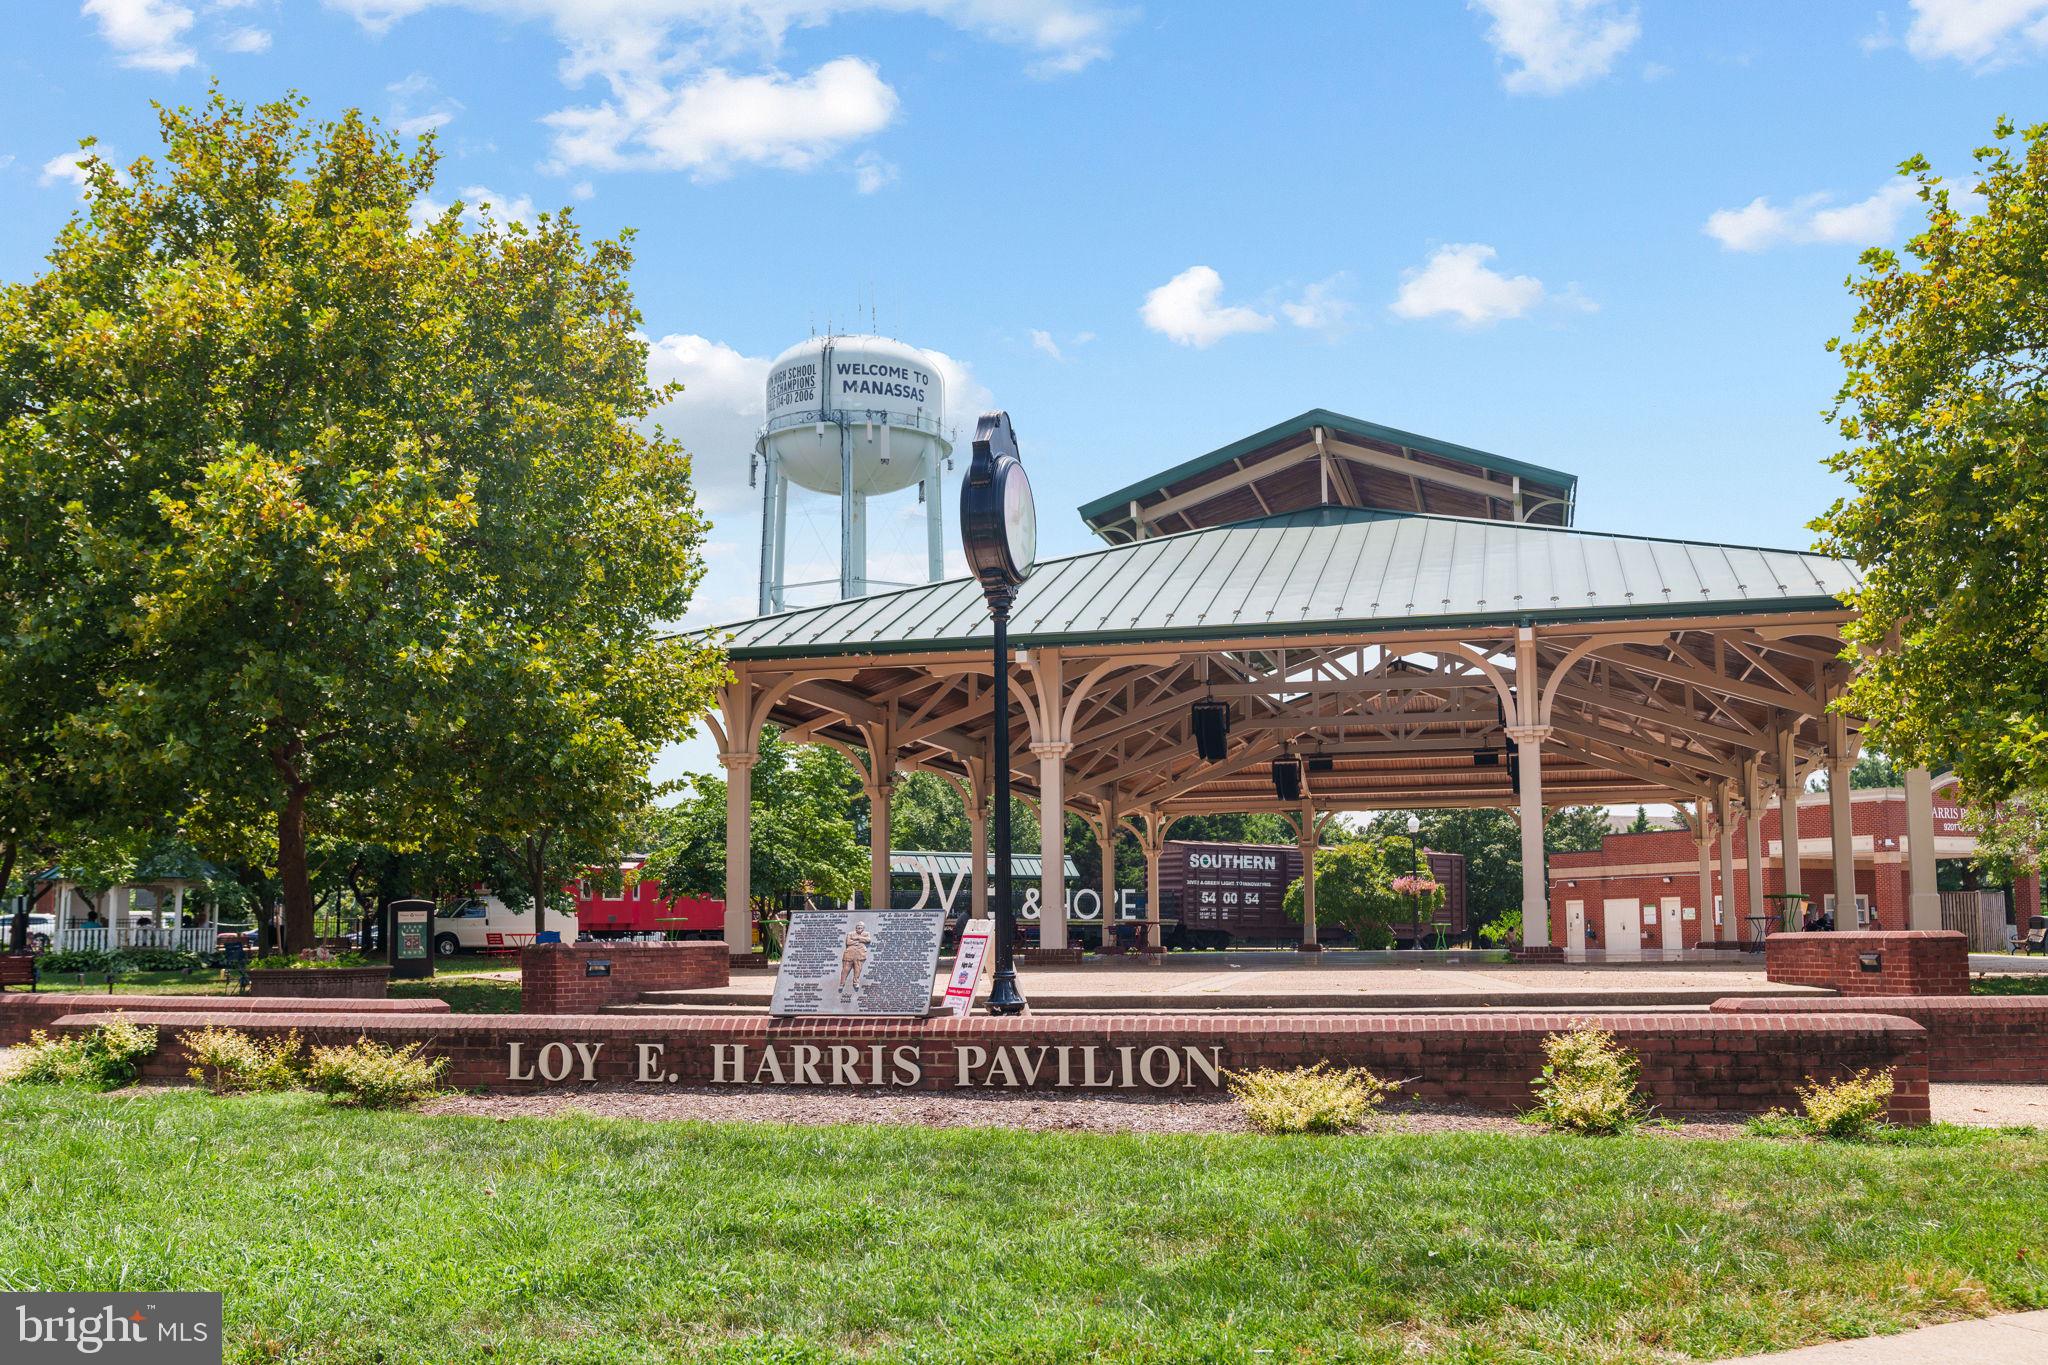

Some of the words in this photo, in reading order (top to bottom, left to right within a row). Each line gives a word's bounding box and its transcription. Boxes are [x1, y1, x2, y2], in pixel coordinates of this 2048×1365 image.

[788, 364, 817, 380] SCHOOL
[837, 363, 909, 380] WELCOME
[913, 371, 929, 386] TO
[776, 375, 815, 396] CHAMPIONS
[842, 380, 926, 402] MANASSAS
[794, 389, 814, 403] 2006
[1931, 807, 1959, 820] ARRIS
[1189, 853, 1276, 870] SOUTHERN
[1201, 891, 1217, 904] 54
[1222, 892, 1238, 904] 00
[1244, 892, 1260, 905] 54
[506, 1042, 605, 1083] LOY
[635, 1043, 679, 1083] E.
[709, 1043, 922, 1087] HARRIS
[953, 1045, 1224, 1088] PAVILION
